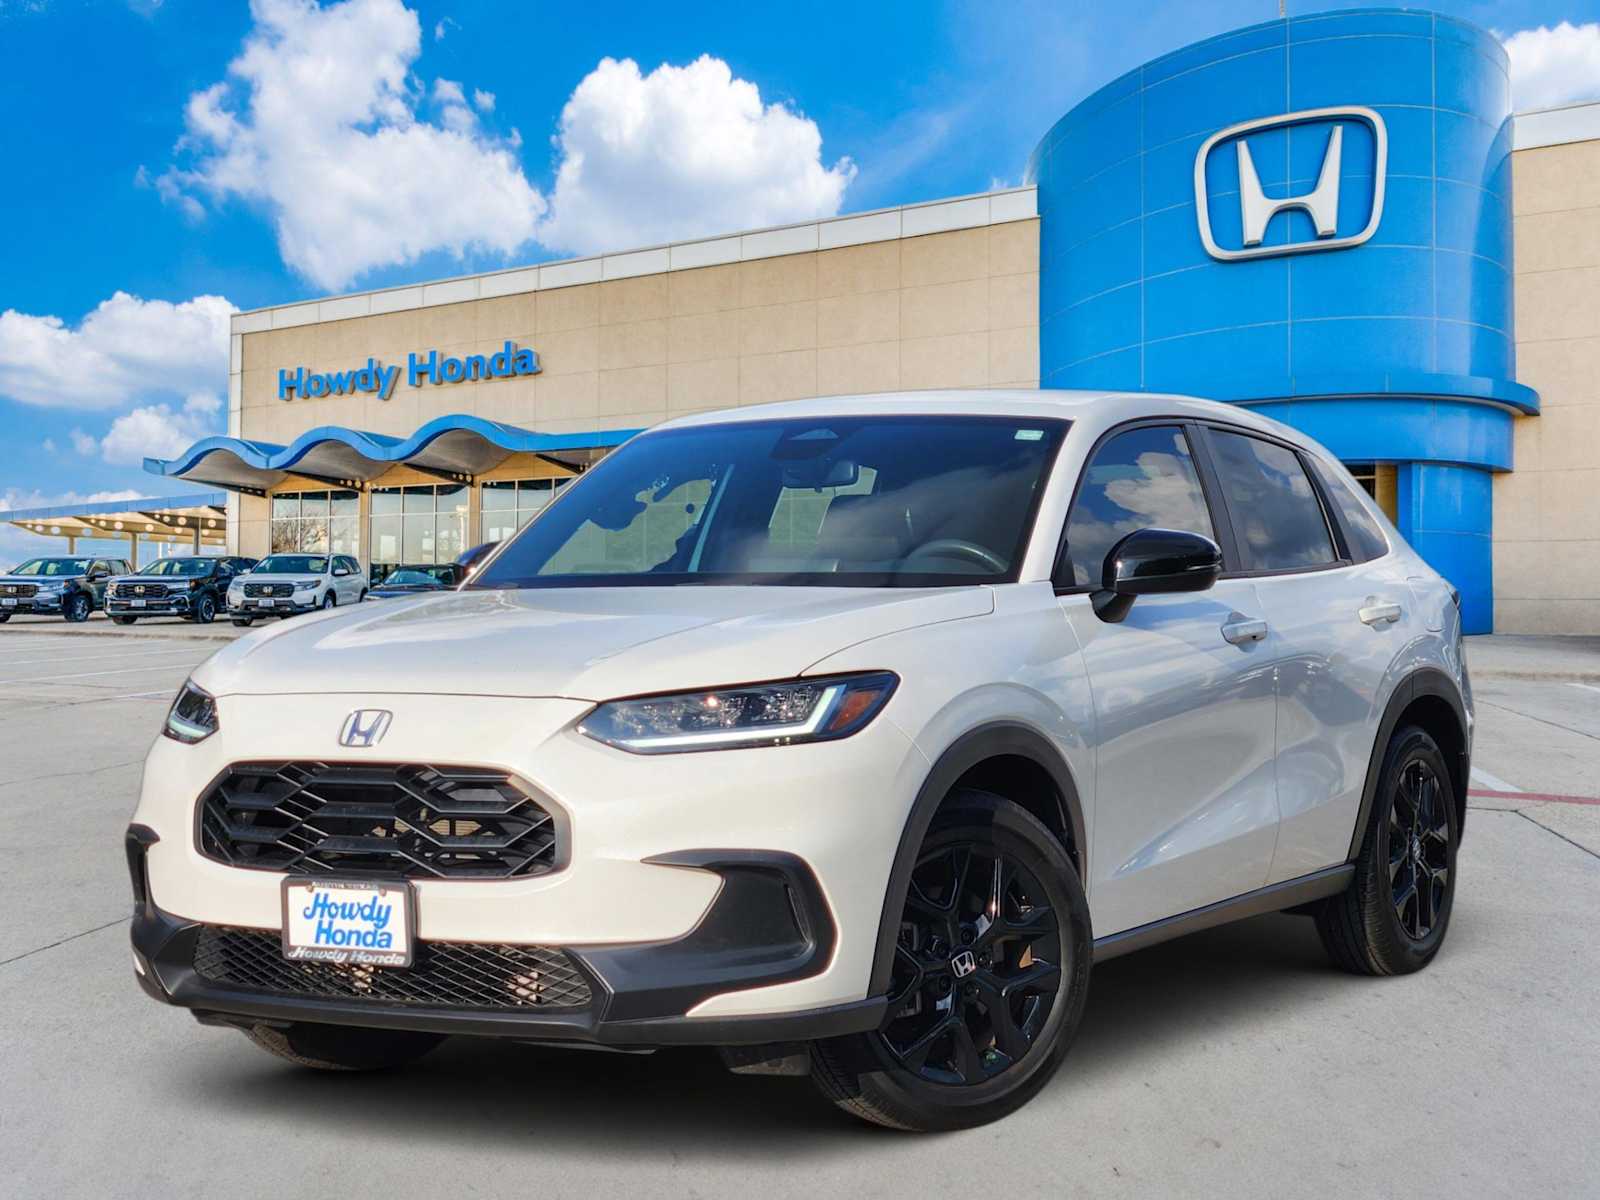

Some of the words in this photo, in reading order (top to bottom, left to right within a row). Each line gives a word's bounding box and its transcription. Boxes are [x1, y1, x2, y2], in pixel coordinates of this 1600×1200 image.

[278, 358, 400, 401] Howdy
[407, 340, 541, 388] Honda
[303, 892, 393, 929] Howdy
[314, 919, 393, 949] Honda
[287, 946, 349, 963] Howdy
[350, 950, 406, 965] Honda
